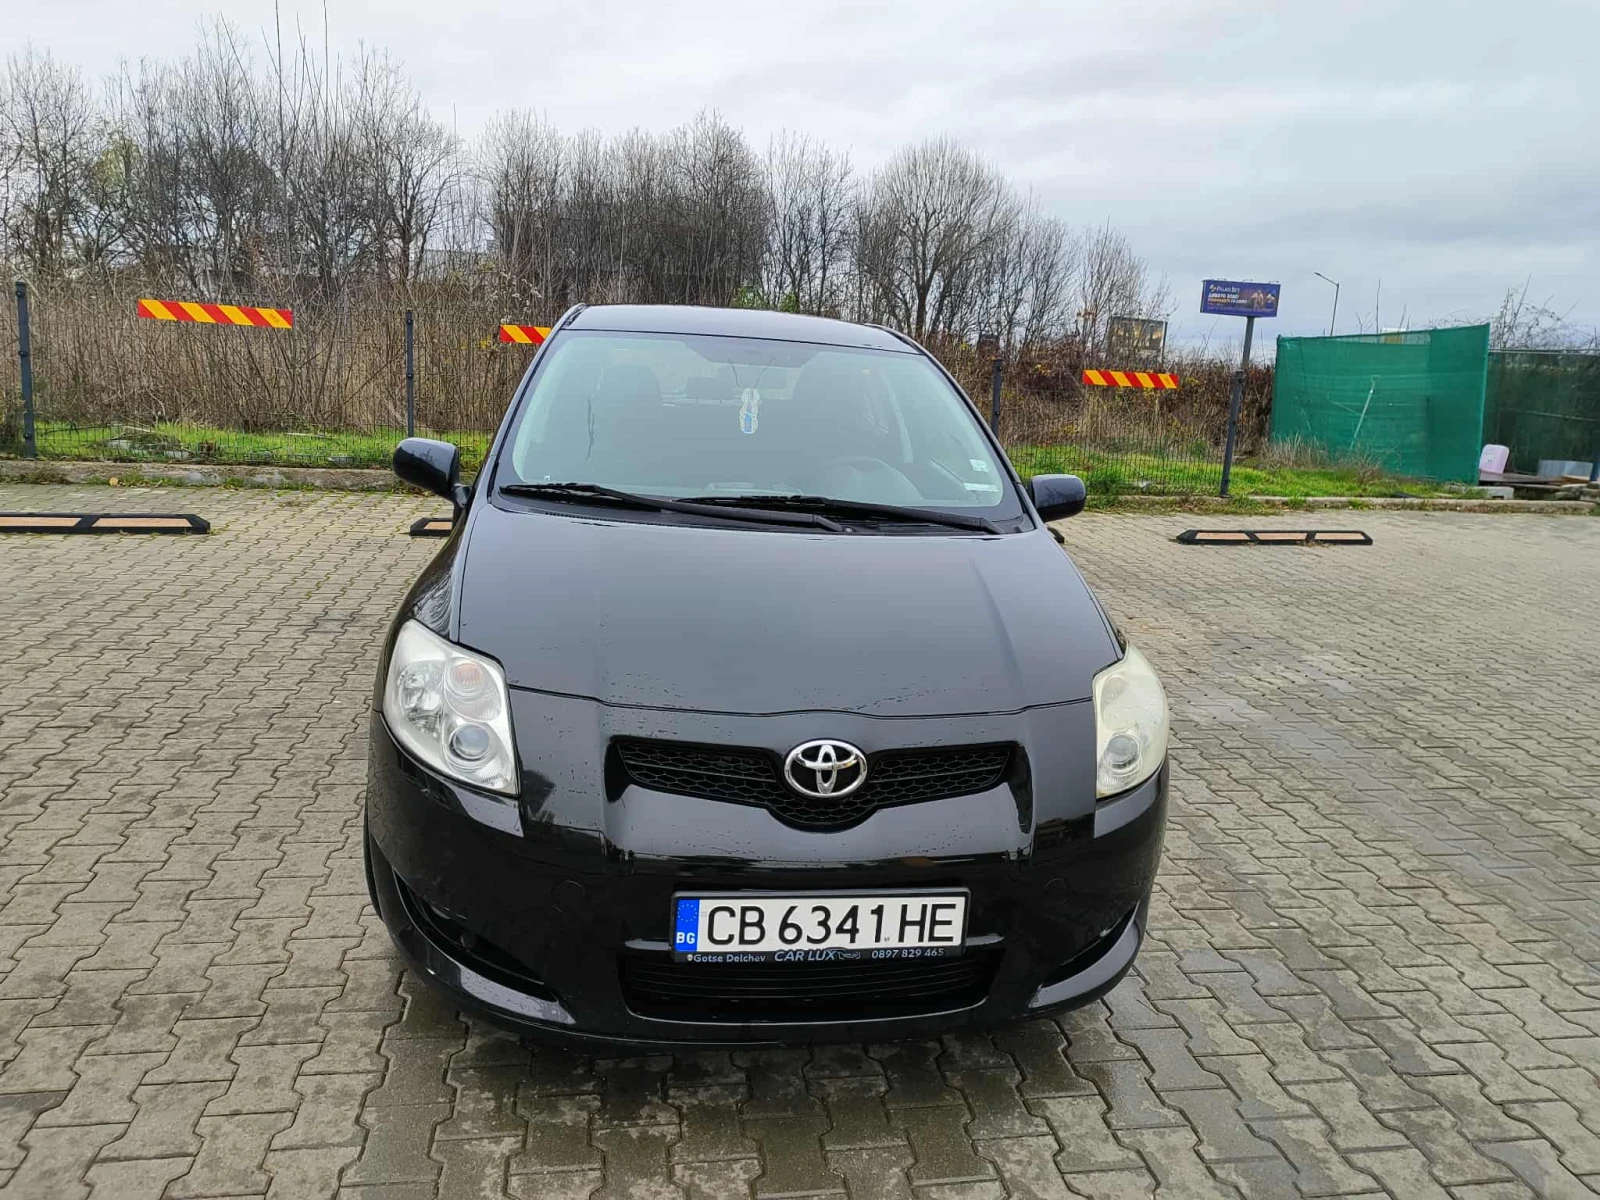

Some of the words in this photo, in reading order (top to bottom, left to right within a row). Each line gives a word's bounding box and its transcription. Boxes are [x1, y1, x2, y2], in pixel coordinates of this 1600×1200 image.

[707, 905, 766, 945] CB
[778, 904, 884, 945] 6341
[898, 903, 957, 943] HE
[675, 931, 696, 944] BG
[693, 954, 723, 963] Gotse
[726, 954, 766, 963] Delchev
[774, 950, 806, 962] CAR
[807, 949, 838, 961] LUX
[871, 949, 899, 959] 0897
[900, 948, 922, 958] 829
[924, 948, 945, 957] 465
